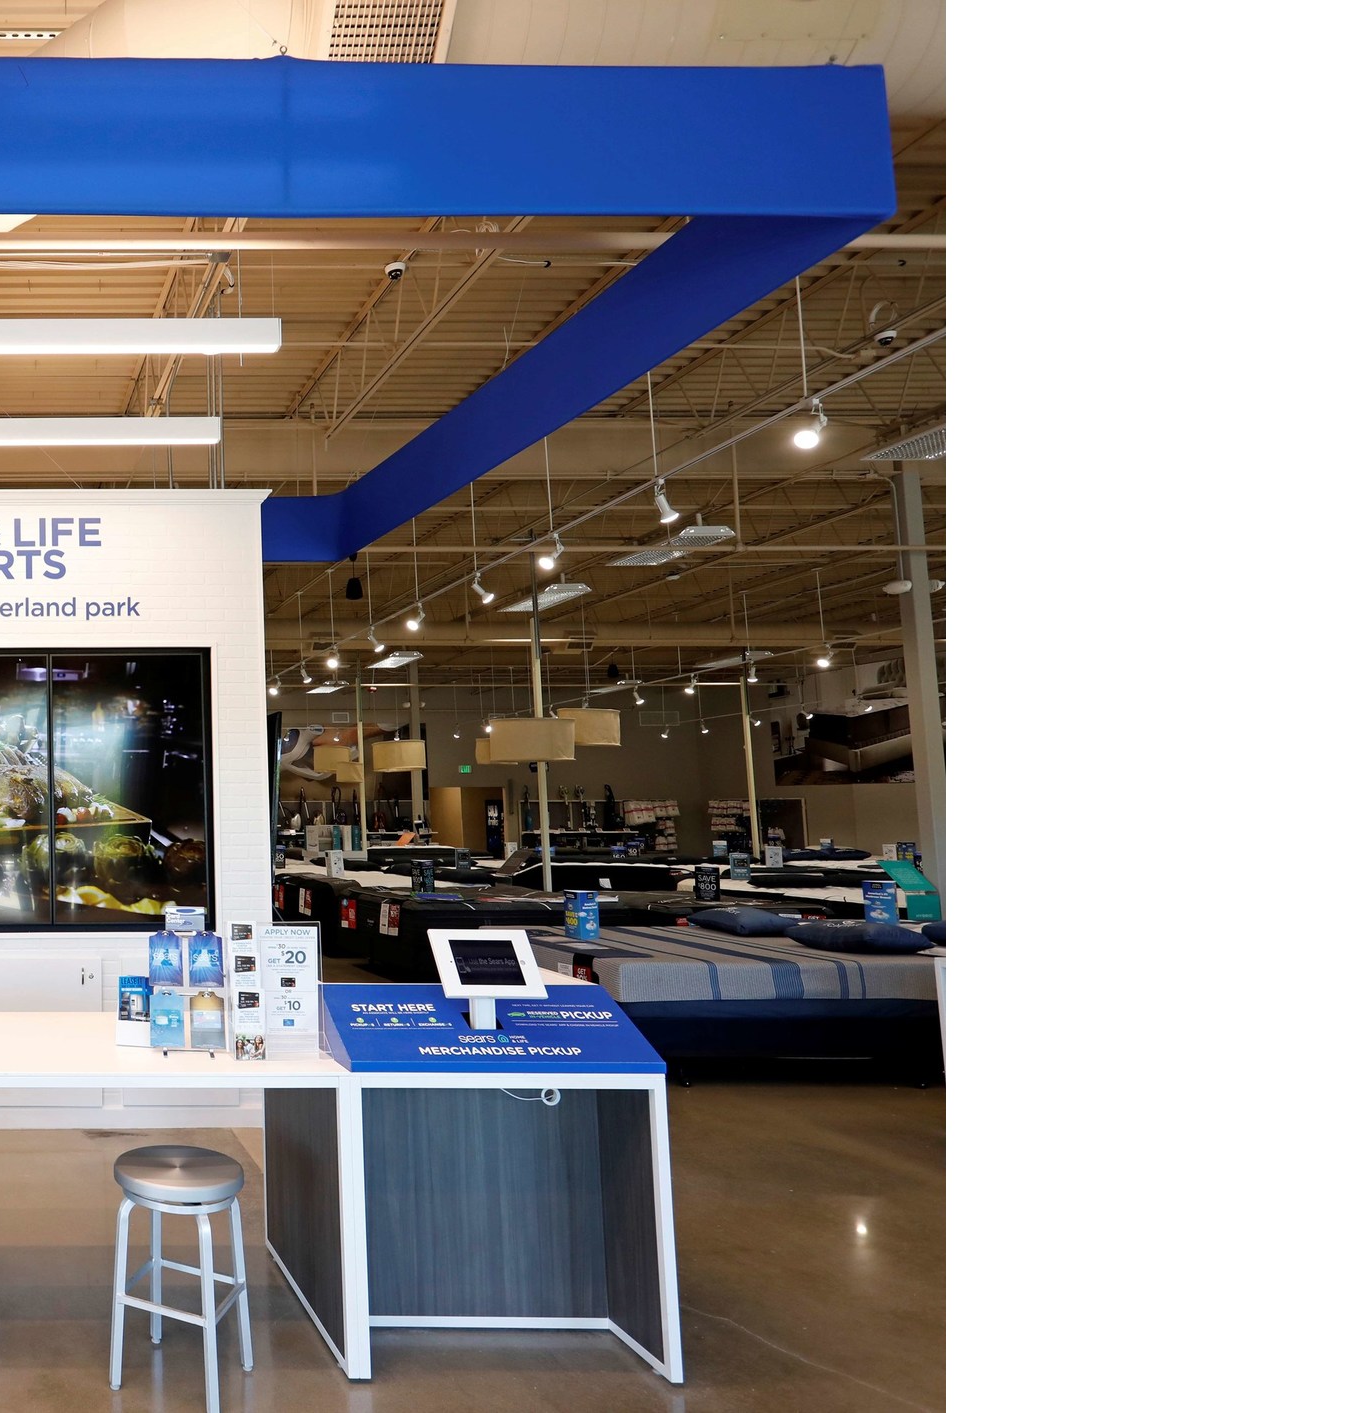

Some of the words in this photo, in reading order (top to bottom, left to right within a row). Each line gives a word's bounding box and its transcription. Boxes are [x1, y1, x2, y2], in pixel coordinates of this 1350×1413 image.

[14, 517, 102, 547] LIFE
[85, 597, 141, 620] park
[698, 883, 717, 891] $800
[265, 928, 288, 936] APPLY
[281, 950, 306, 964] $20
[504, 958, 516, 967] App
[284, 1000, 301, 1011] $10
[351, 1004, 393, 1012] START
[397, 1004, 436, 1012] HERE
[559, 1011, 613, 1020] PICKUP
[458, 1035, 496, 1044] sears
[418, 1046, 527, 1056] MERCHANDISE
[528, 1046, 582, 1056] PICKUP
